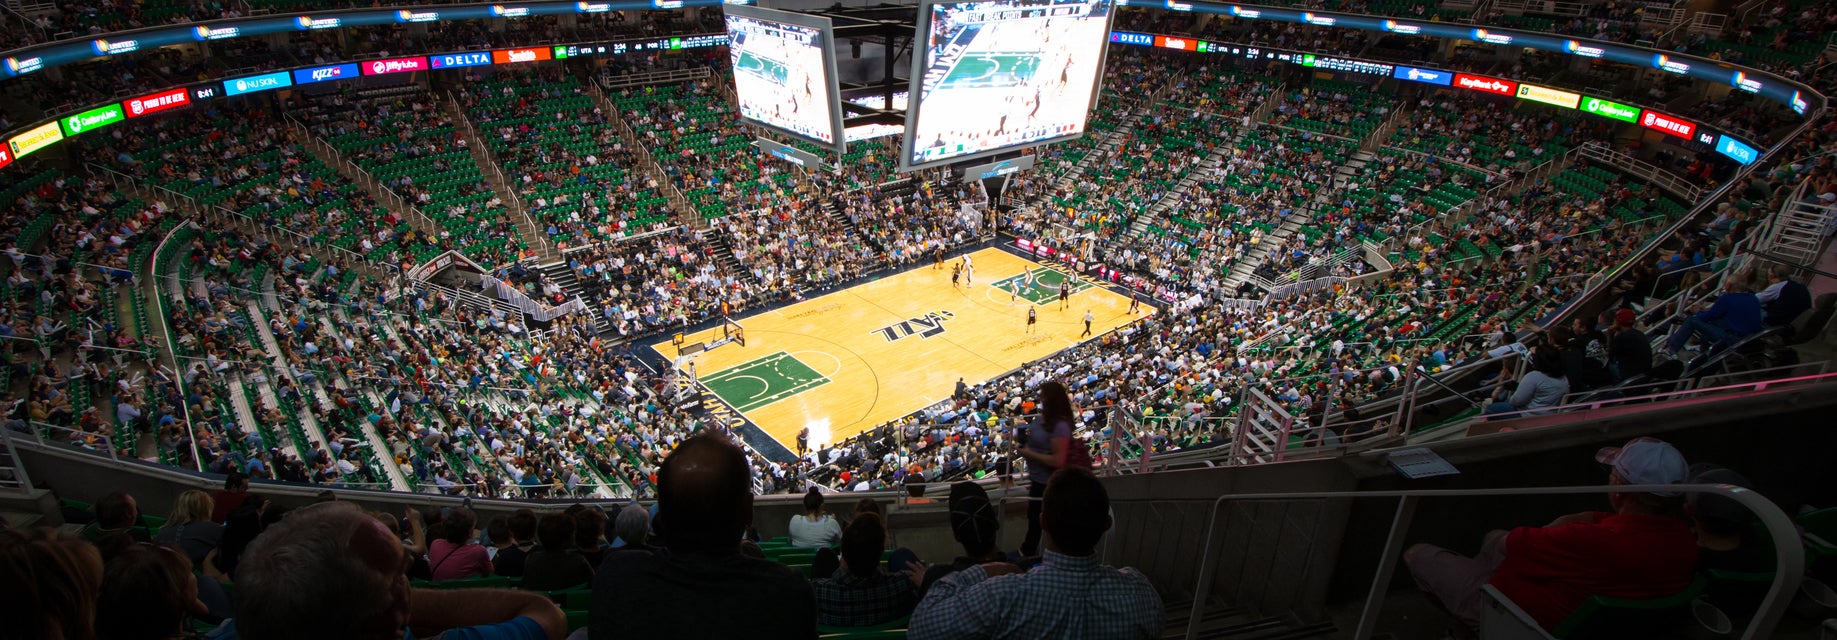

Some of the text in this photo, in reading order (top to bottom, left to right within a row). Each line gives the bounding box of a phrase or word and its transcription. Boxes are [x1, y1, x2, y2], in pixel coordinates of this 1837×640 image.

[968, 12, 981, 22] FAST
[985, 11, 1001, 20] BREAK
[208, 27, 238, 35] UNITED
[1121, 34, 1151, 44] DELTA
[108, 40, 137, 50] UNITED
[445, 54, 489, 66] DELTA
[1278, 53, 1290, 61] POR
[246, 77, 278, 88] NU SKIN
[1460, 77, 1492, 91] KeyBank
[171, 92, 185, 103] HERE
[703, 398, 746, 429] UTAH
